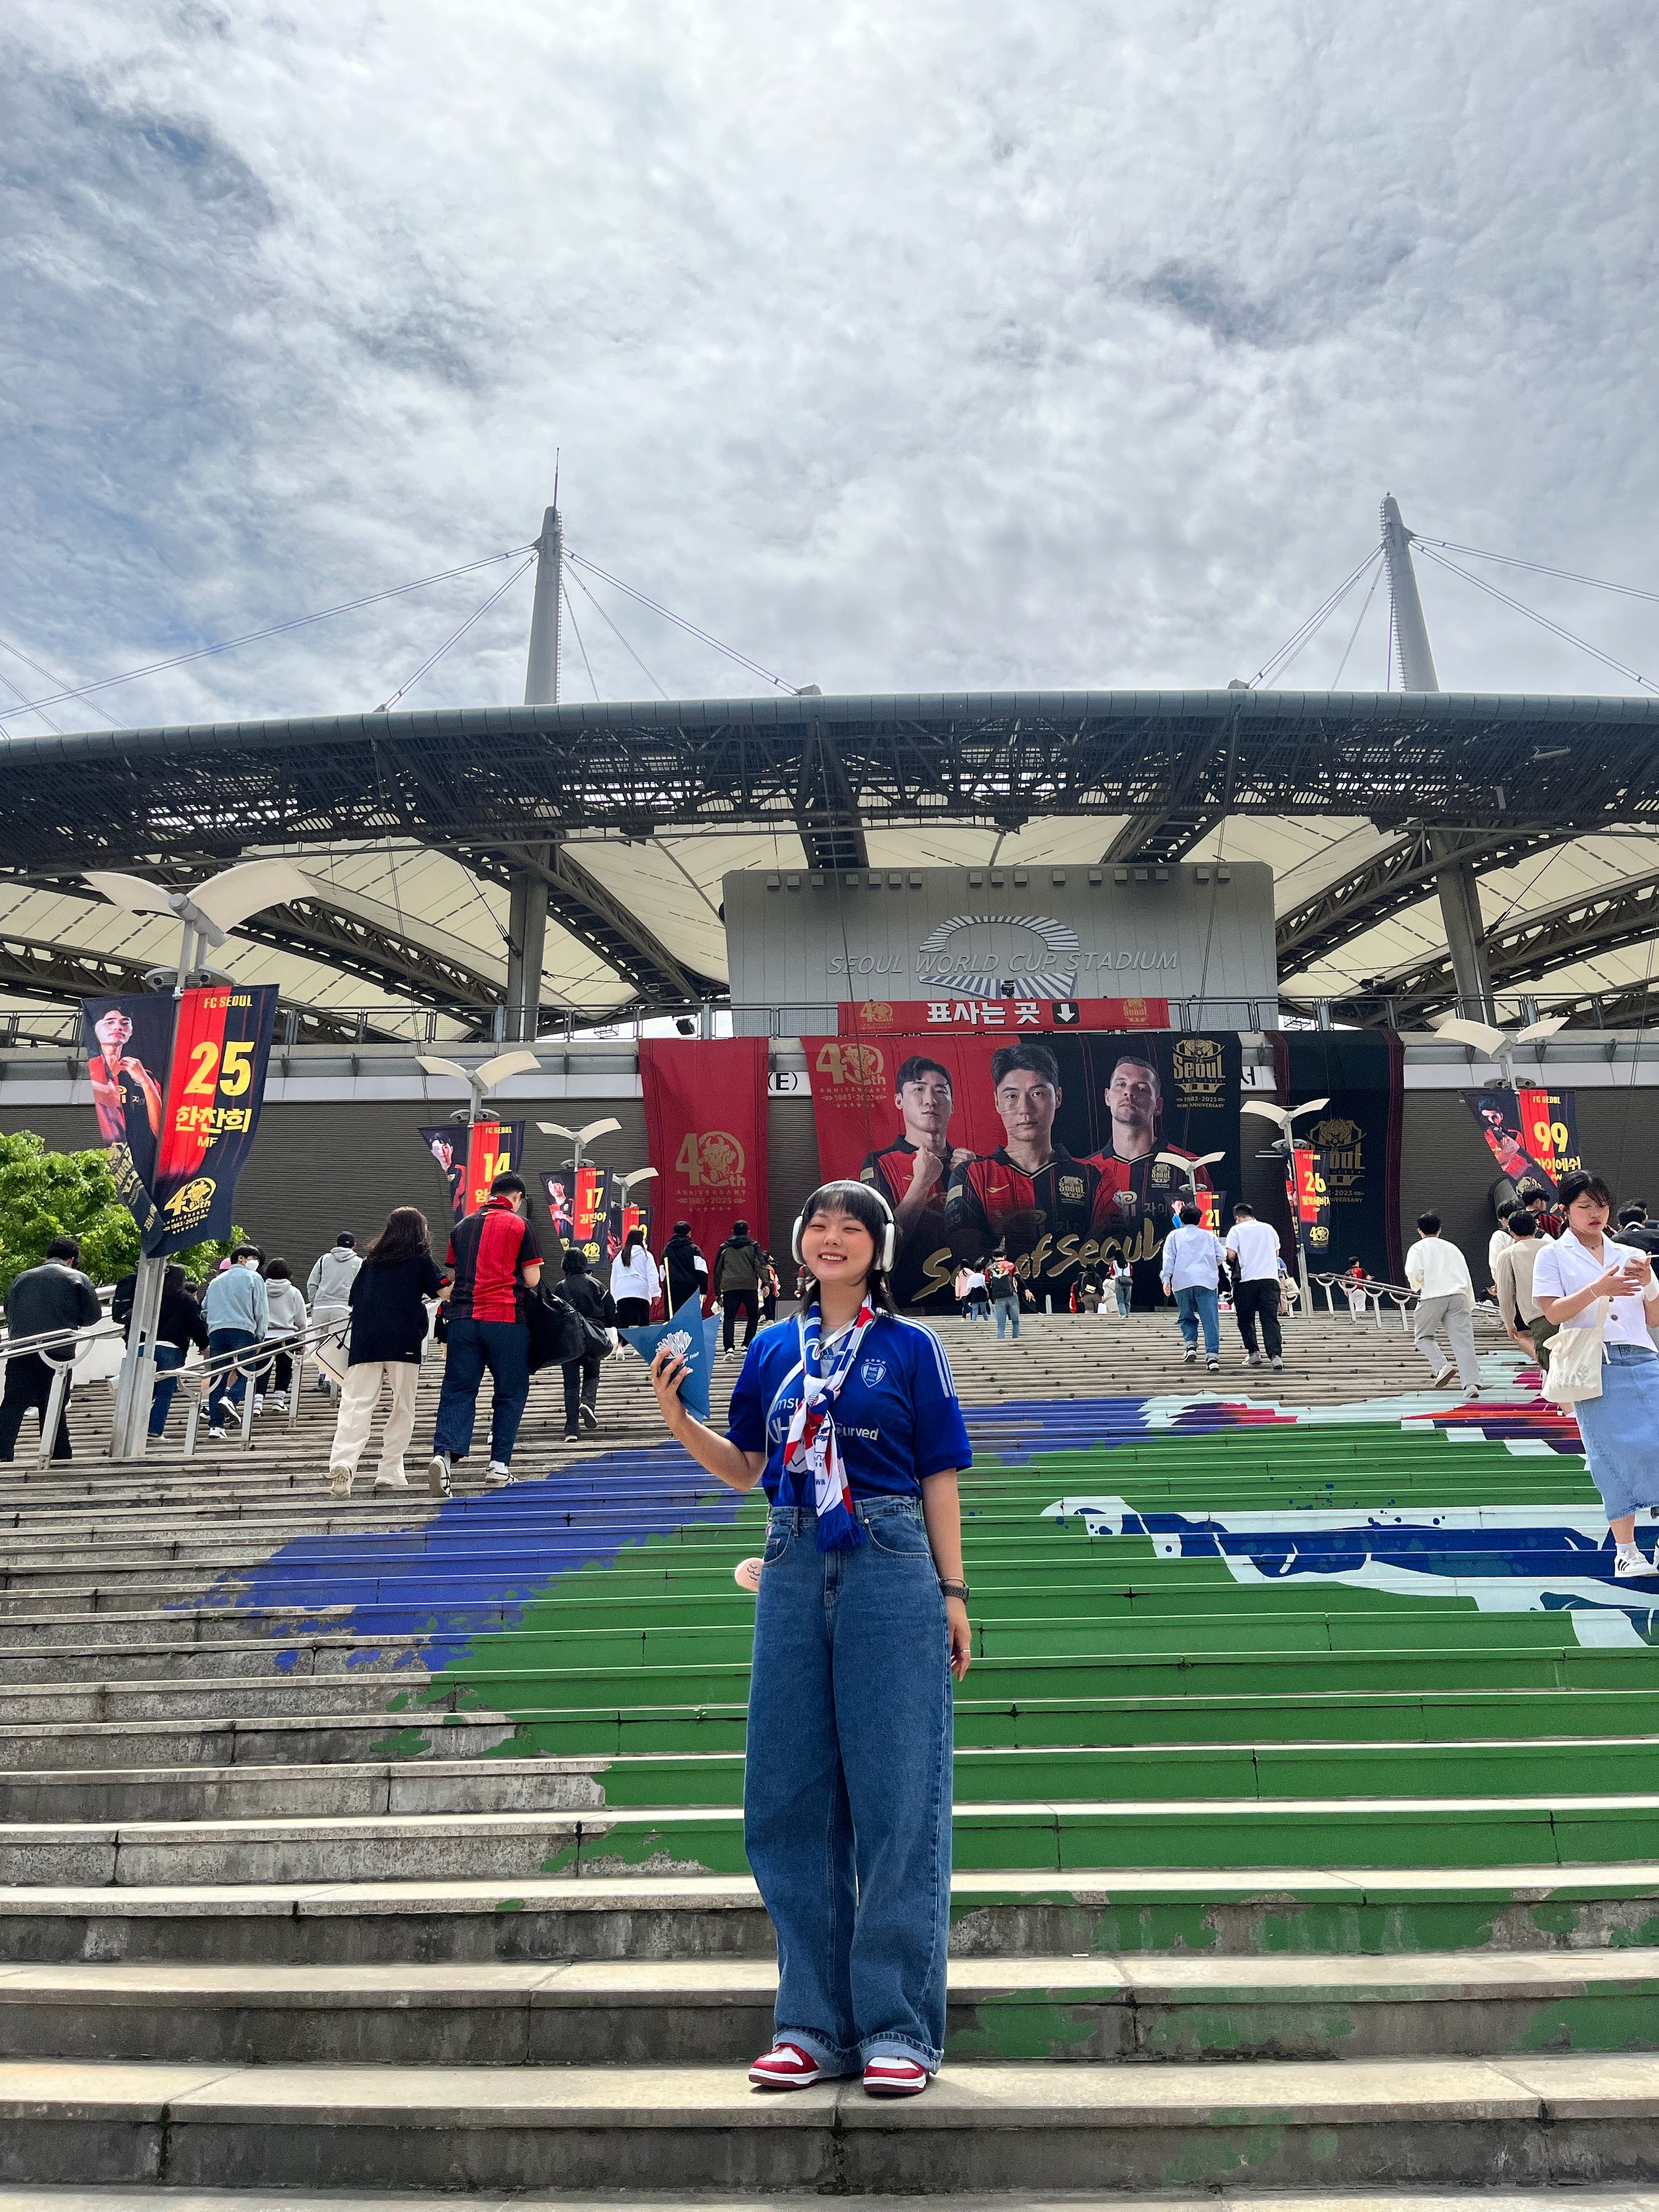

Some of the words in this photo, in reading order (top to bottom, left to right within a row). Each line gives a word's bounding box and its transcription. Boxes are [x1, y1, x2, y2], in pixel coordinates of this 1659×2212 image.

[827, 955, 904, 974] SEOUL
[915, 954, 1000, 974] WORLD
[1009, 953, 1058, 972] CUP
[1065, 951, 1179, 971] STADIUM
[203, 997, 217, 1009] FC
[219, 995, 253, 1008] SEOUL
[927, 1001, 1006, 1025] 표사는
[1014, 1002, 1041, 1025] 곳
[183, 1041, 255, 1096] 25
[175, 1105, 252, 1134] 한찬희
[196, 1136, 218, 1148] MF
[1533, 1122, 1569, 1153] 99
[483, 1152, 512, 1183] 14
[1304, 1171, 1327, 1192] 26
[586, 1187, 604, 1209] 17
[1205, 1209, 1220, 1227] 21
